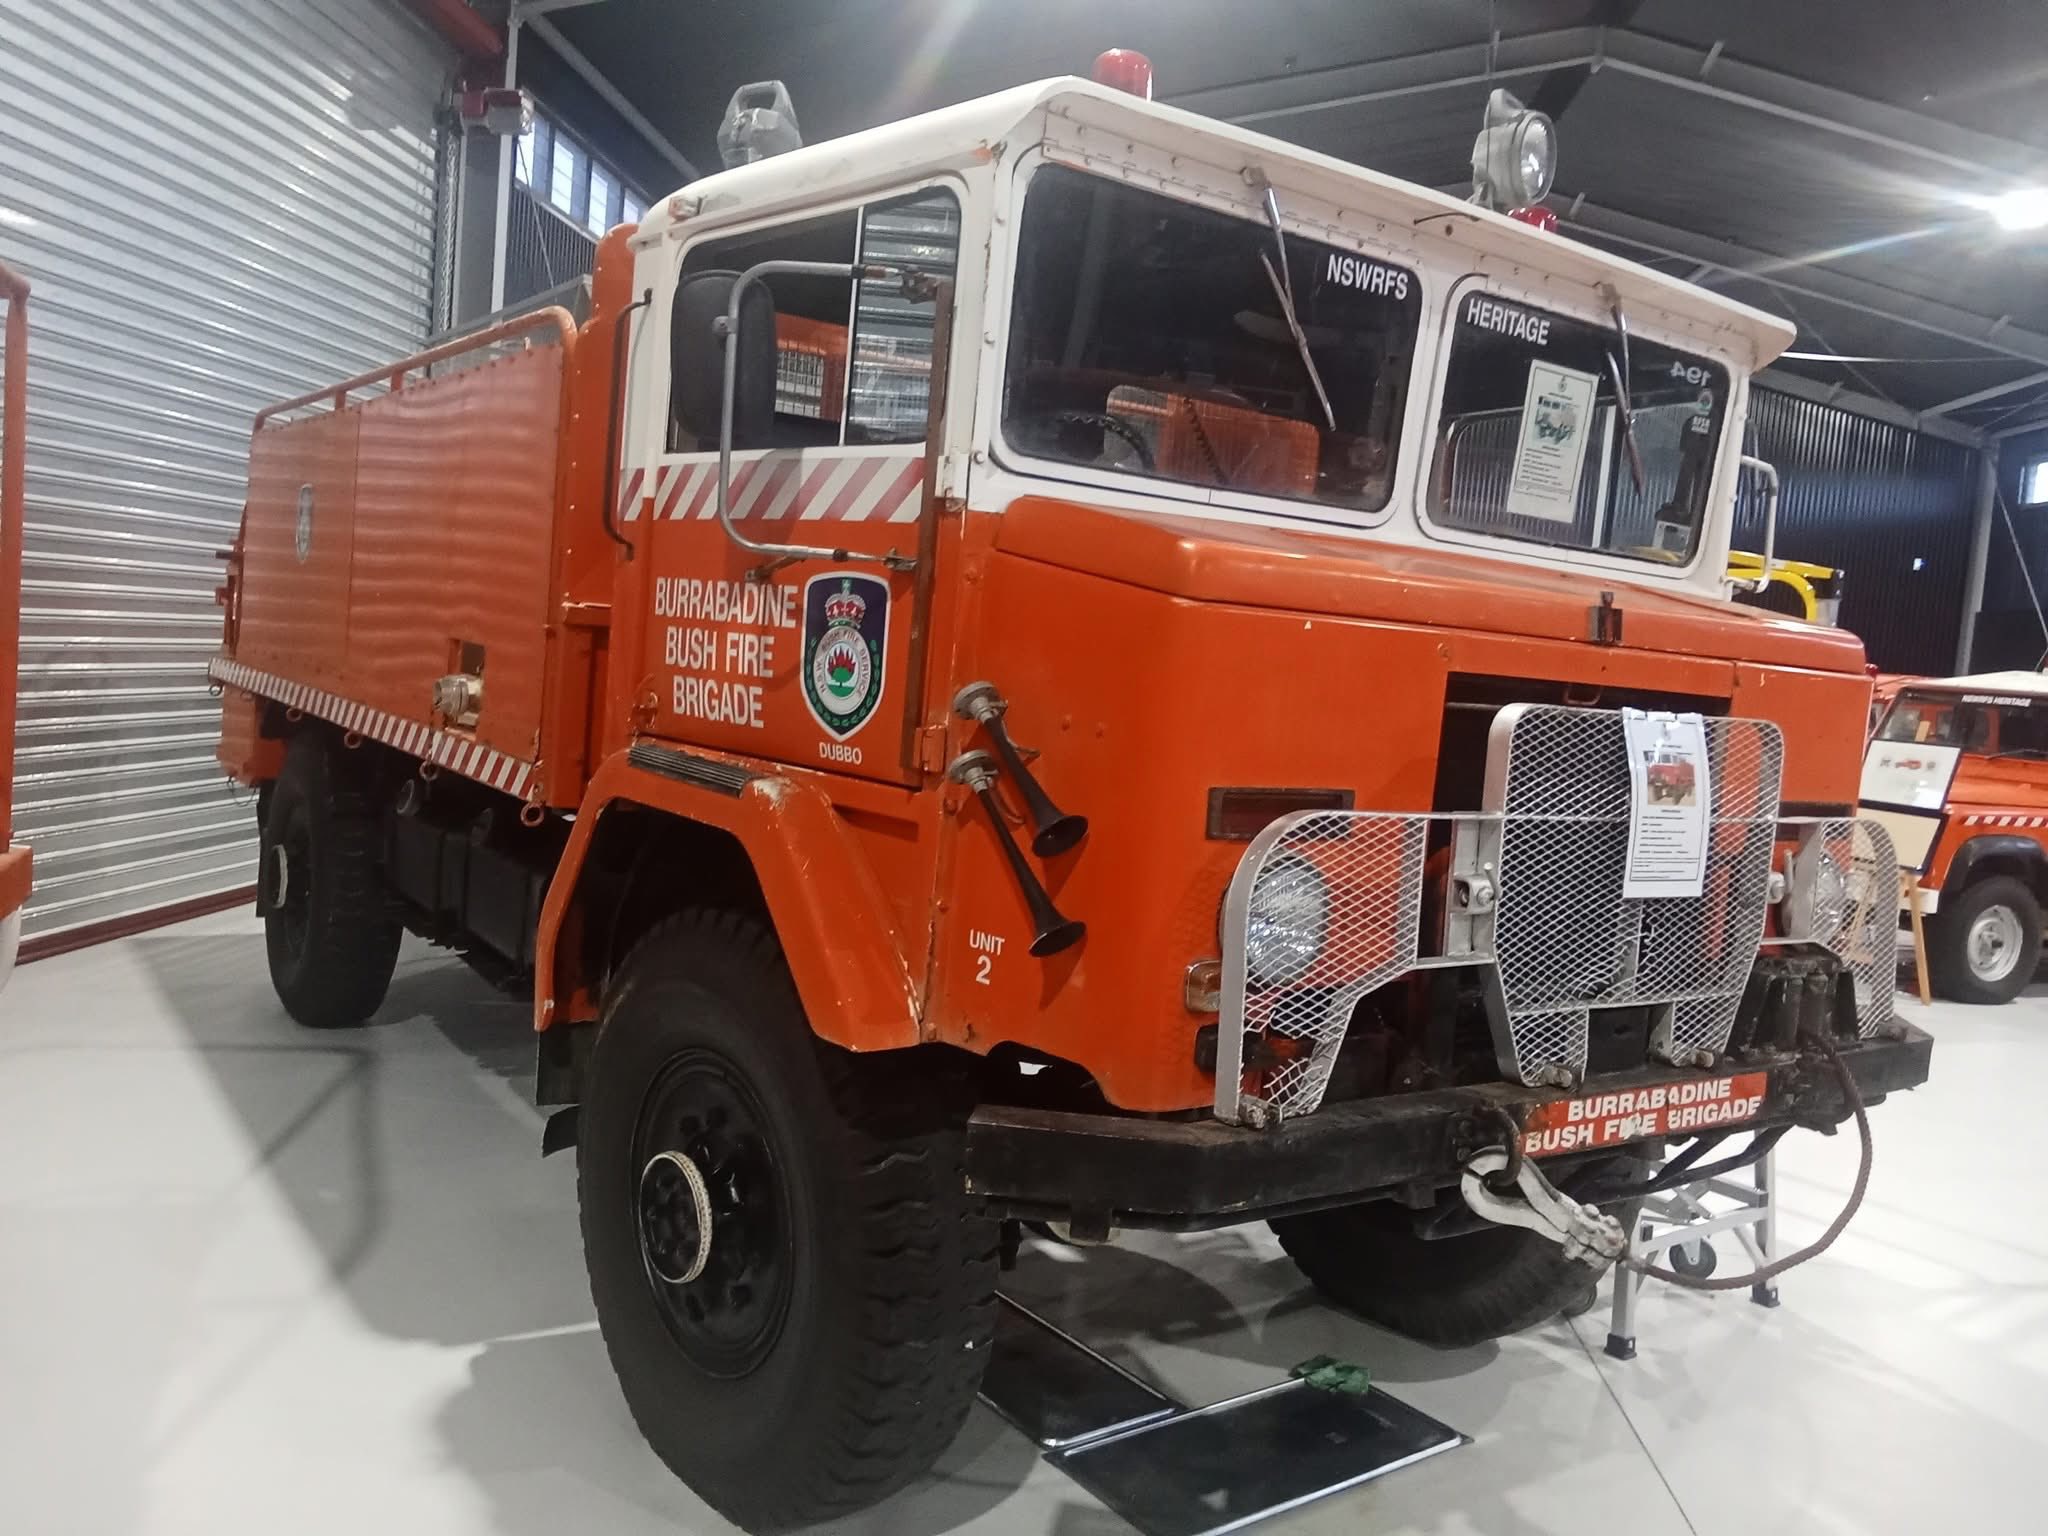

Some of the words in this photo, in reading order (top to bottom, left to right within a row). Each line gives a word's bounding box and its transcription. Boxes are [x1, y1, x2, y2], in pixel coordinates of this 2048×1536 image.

[1327, 253, 1409, 301] NSWRFS
[1466, 298, 1551, 346] HERITAGE
[655, 577, 798, 628] BURRABADINE
[665, 626, 717, 671] BUSH
[725, 632, 775, 678] FIRE
[672, 676, 764, 728] BRIGADE
[819, 742, 862, 765] DUBBO
[969, 928, 1006, 956] UNIT
[975, 954, 992, 985] 2
[1567, 1078, 1733, 1122] BURRABADINE
[1524, 1125, 1594, 1153] BUSH
[1667, 1096, 1762, 1130] BRIGADE
